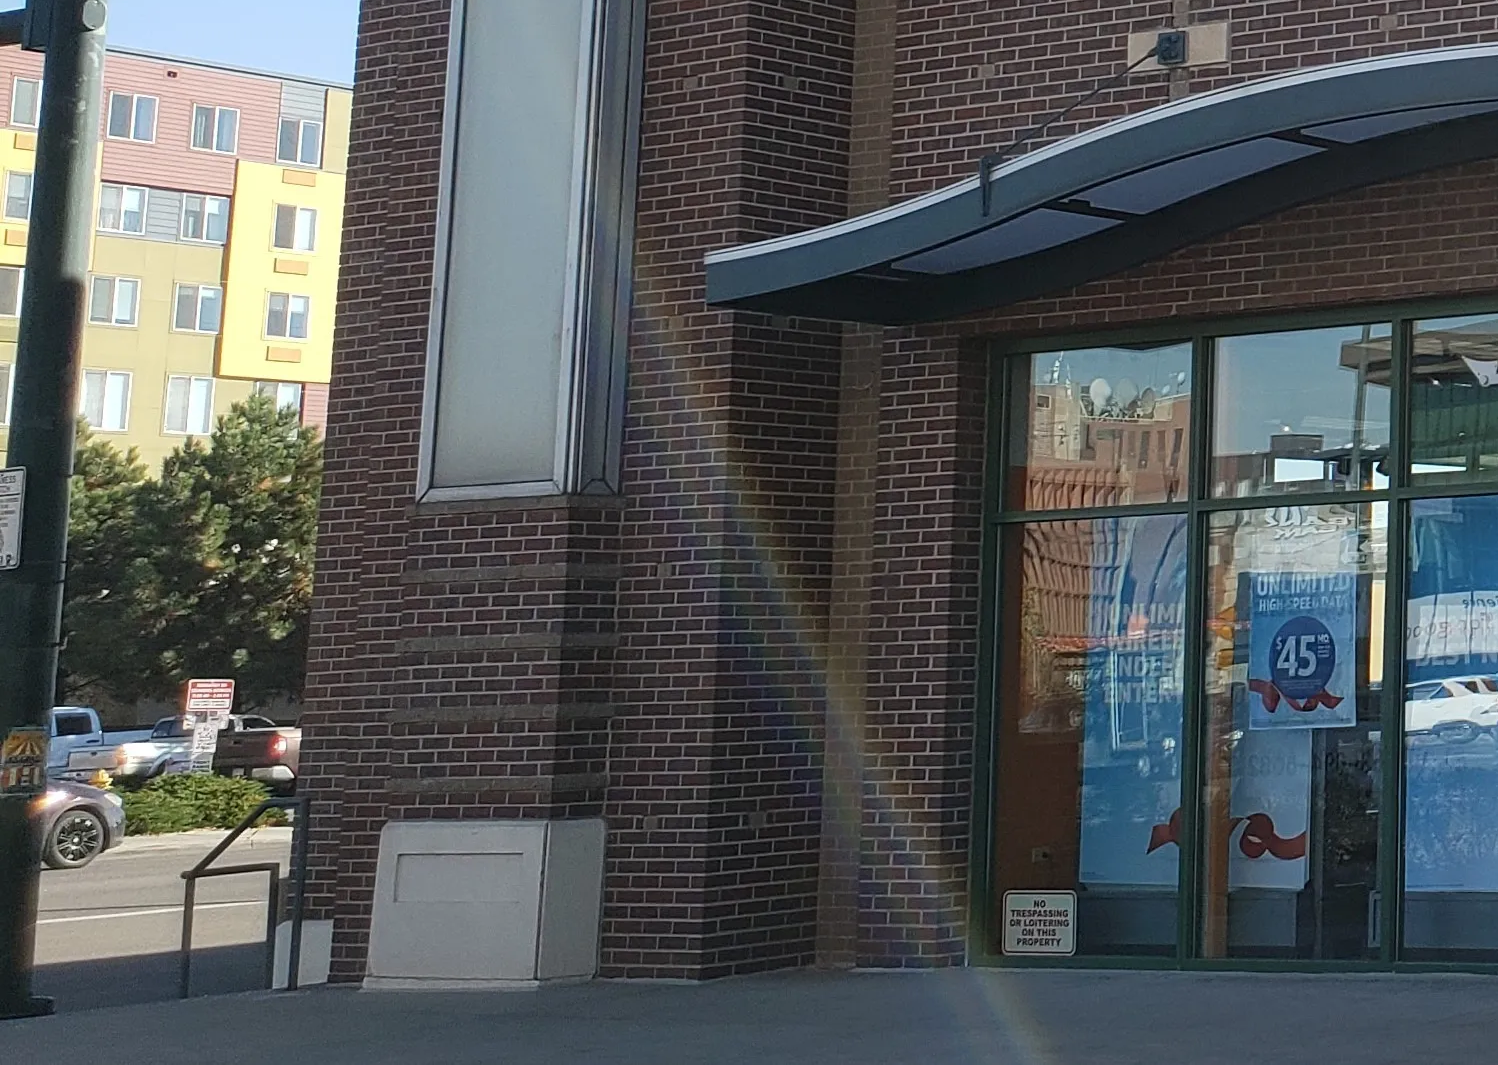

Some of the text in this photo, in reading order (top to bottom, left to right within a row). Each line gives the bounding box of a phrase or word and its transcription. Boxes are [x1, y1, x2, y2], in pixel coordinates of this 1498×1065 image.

[1033, 899, 1046, 908] NO
[1010, 909, 1069, 918] TRESPASSING
[1009, 918, 1070, 927] OR LOITERING
[1021, 928, 1057, 937] ON THIS
[1016, 937, 1062, 947] PROPERTY
